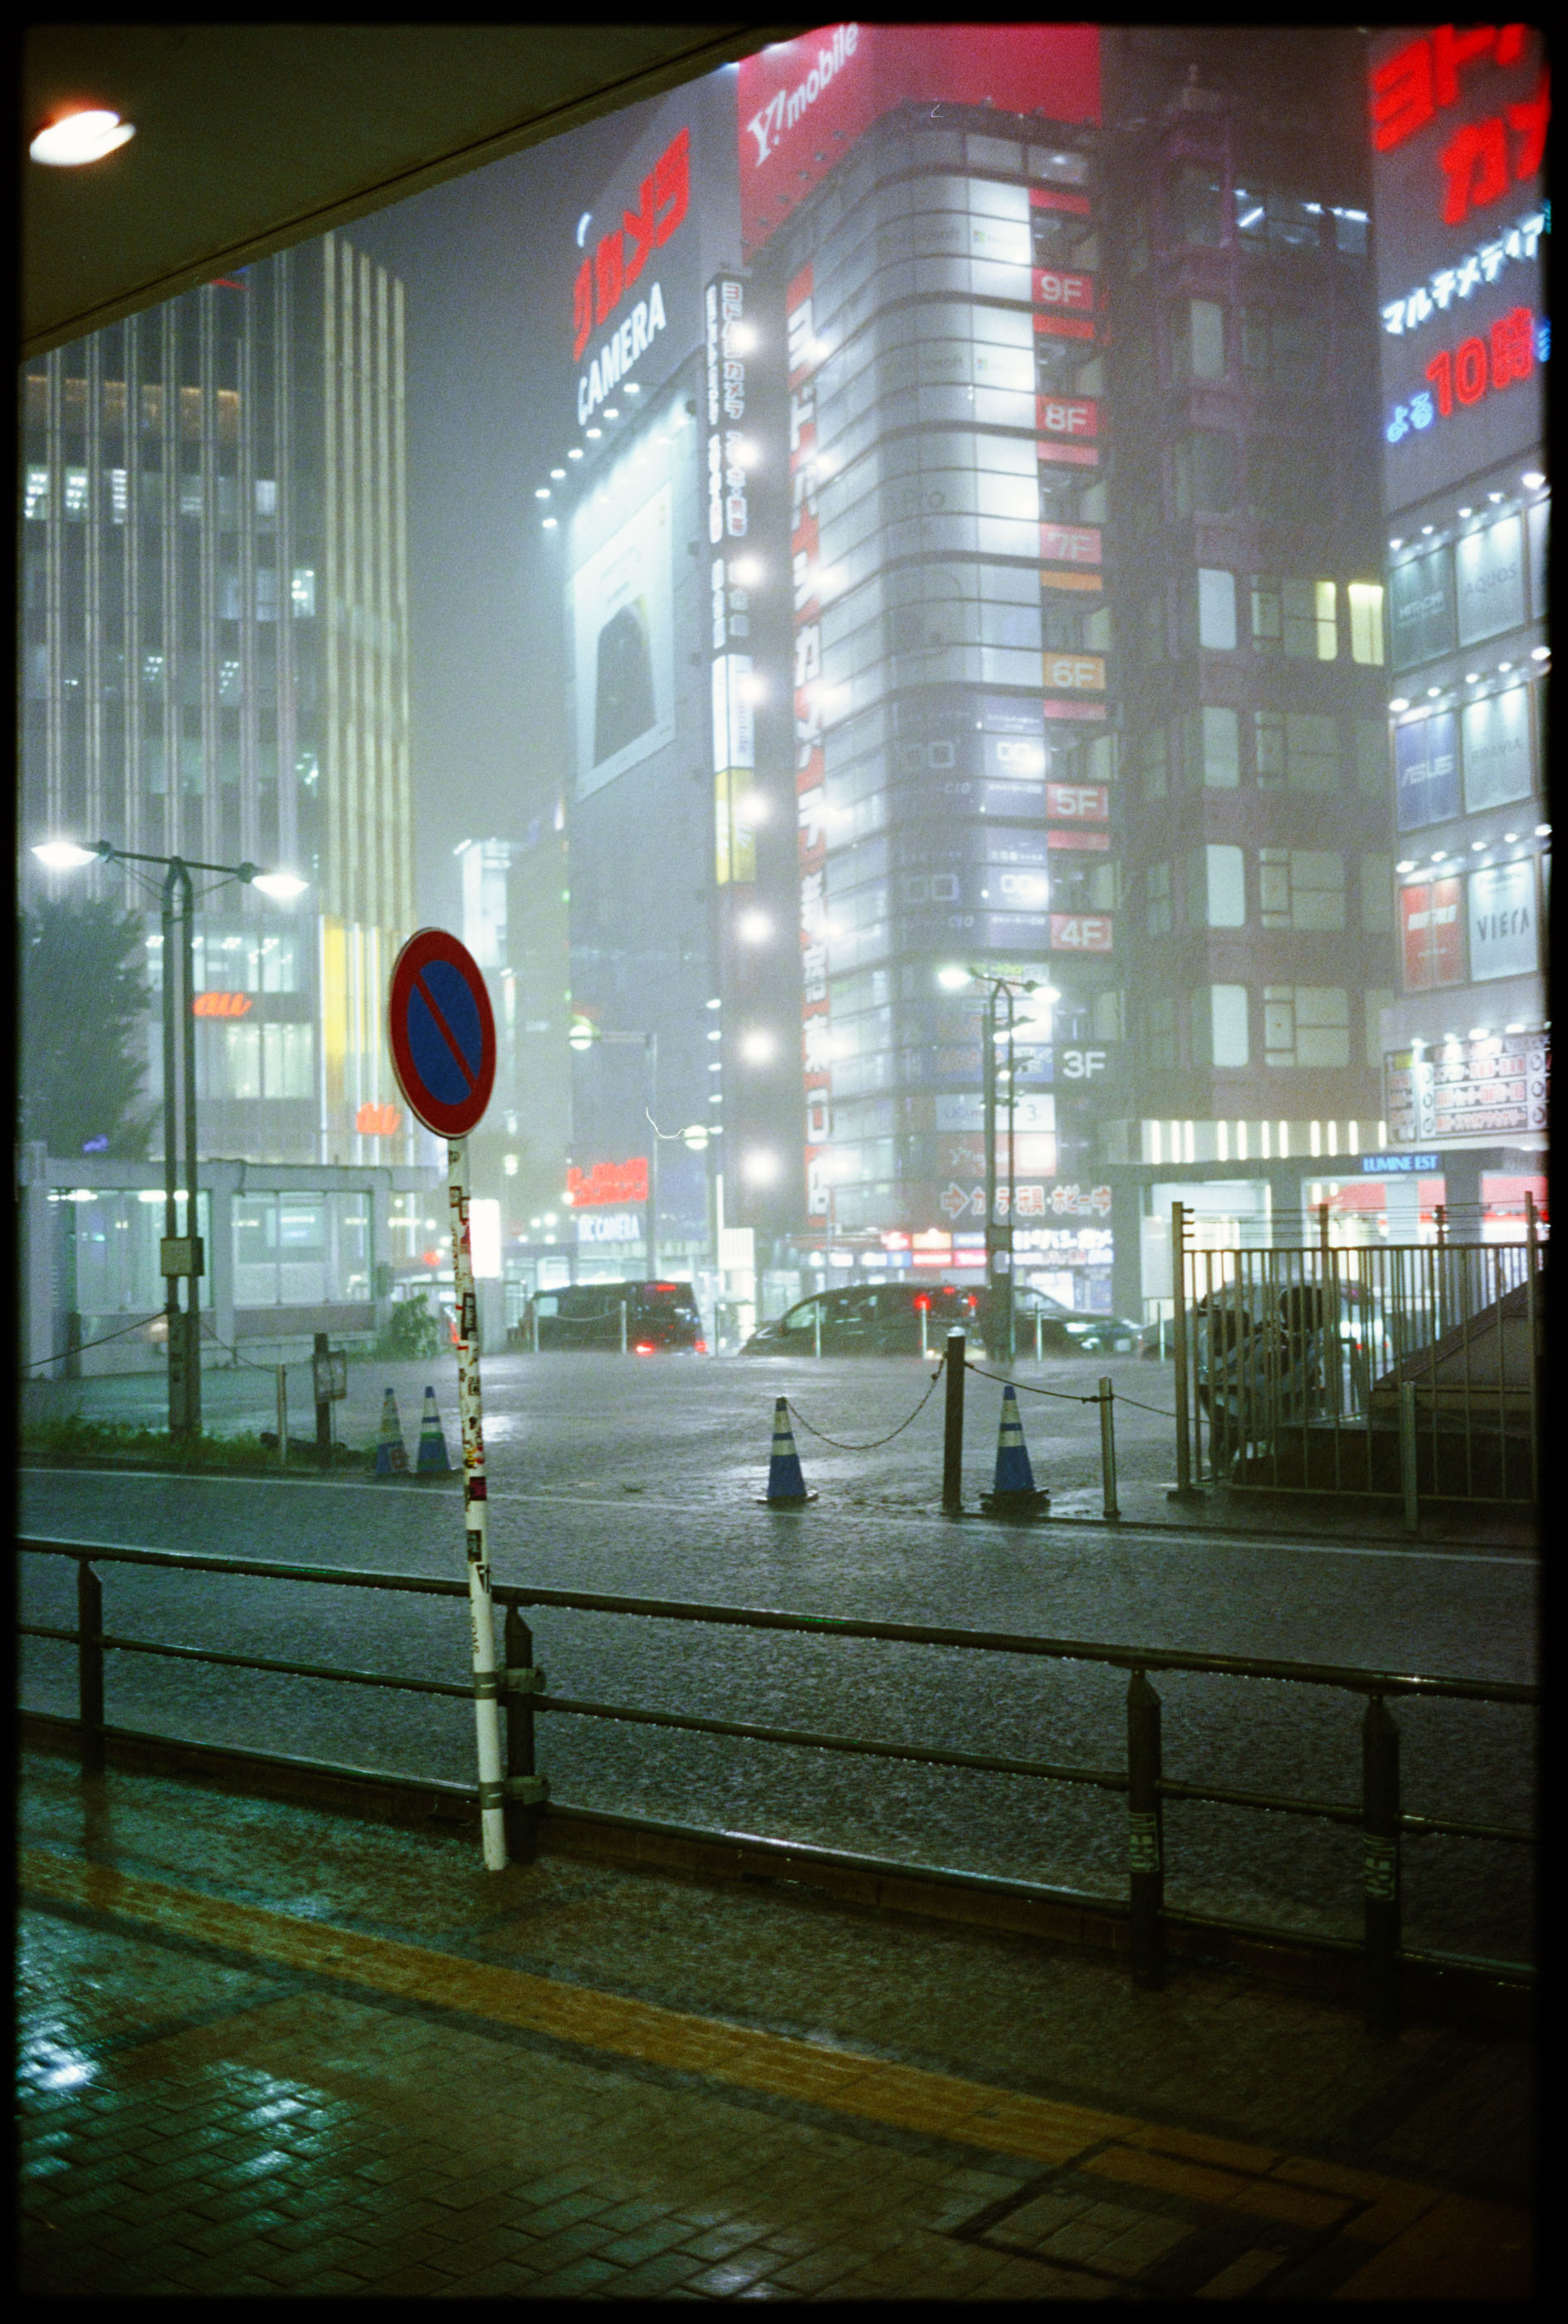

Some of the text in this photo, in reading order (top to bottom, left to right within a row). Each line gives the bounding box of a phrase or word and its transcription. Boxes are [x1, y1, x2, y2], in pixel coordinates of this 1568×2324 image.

[747, 22, 858, 168] Y!mobile
[1041, 276, 1082, 303] 9F
[578, 281, 666, 426] CAMERA
[1045, 403, 1087, 432] 8F
[1048, 531, 1092, 559] 7F
[1052, 657, 1097, 688] 6F
[1400, 754, 1454, 788] ASUS
[1056, 788, 1099, 815] 5F
[1059, 919, 1103, 947] 4F
[1062, 1049, 1106, 1078] 3F
[1363, 1155, 1439, 1172] LUMINE EST
